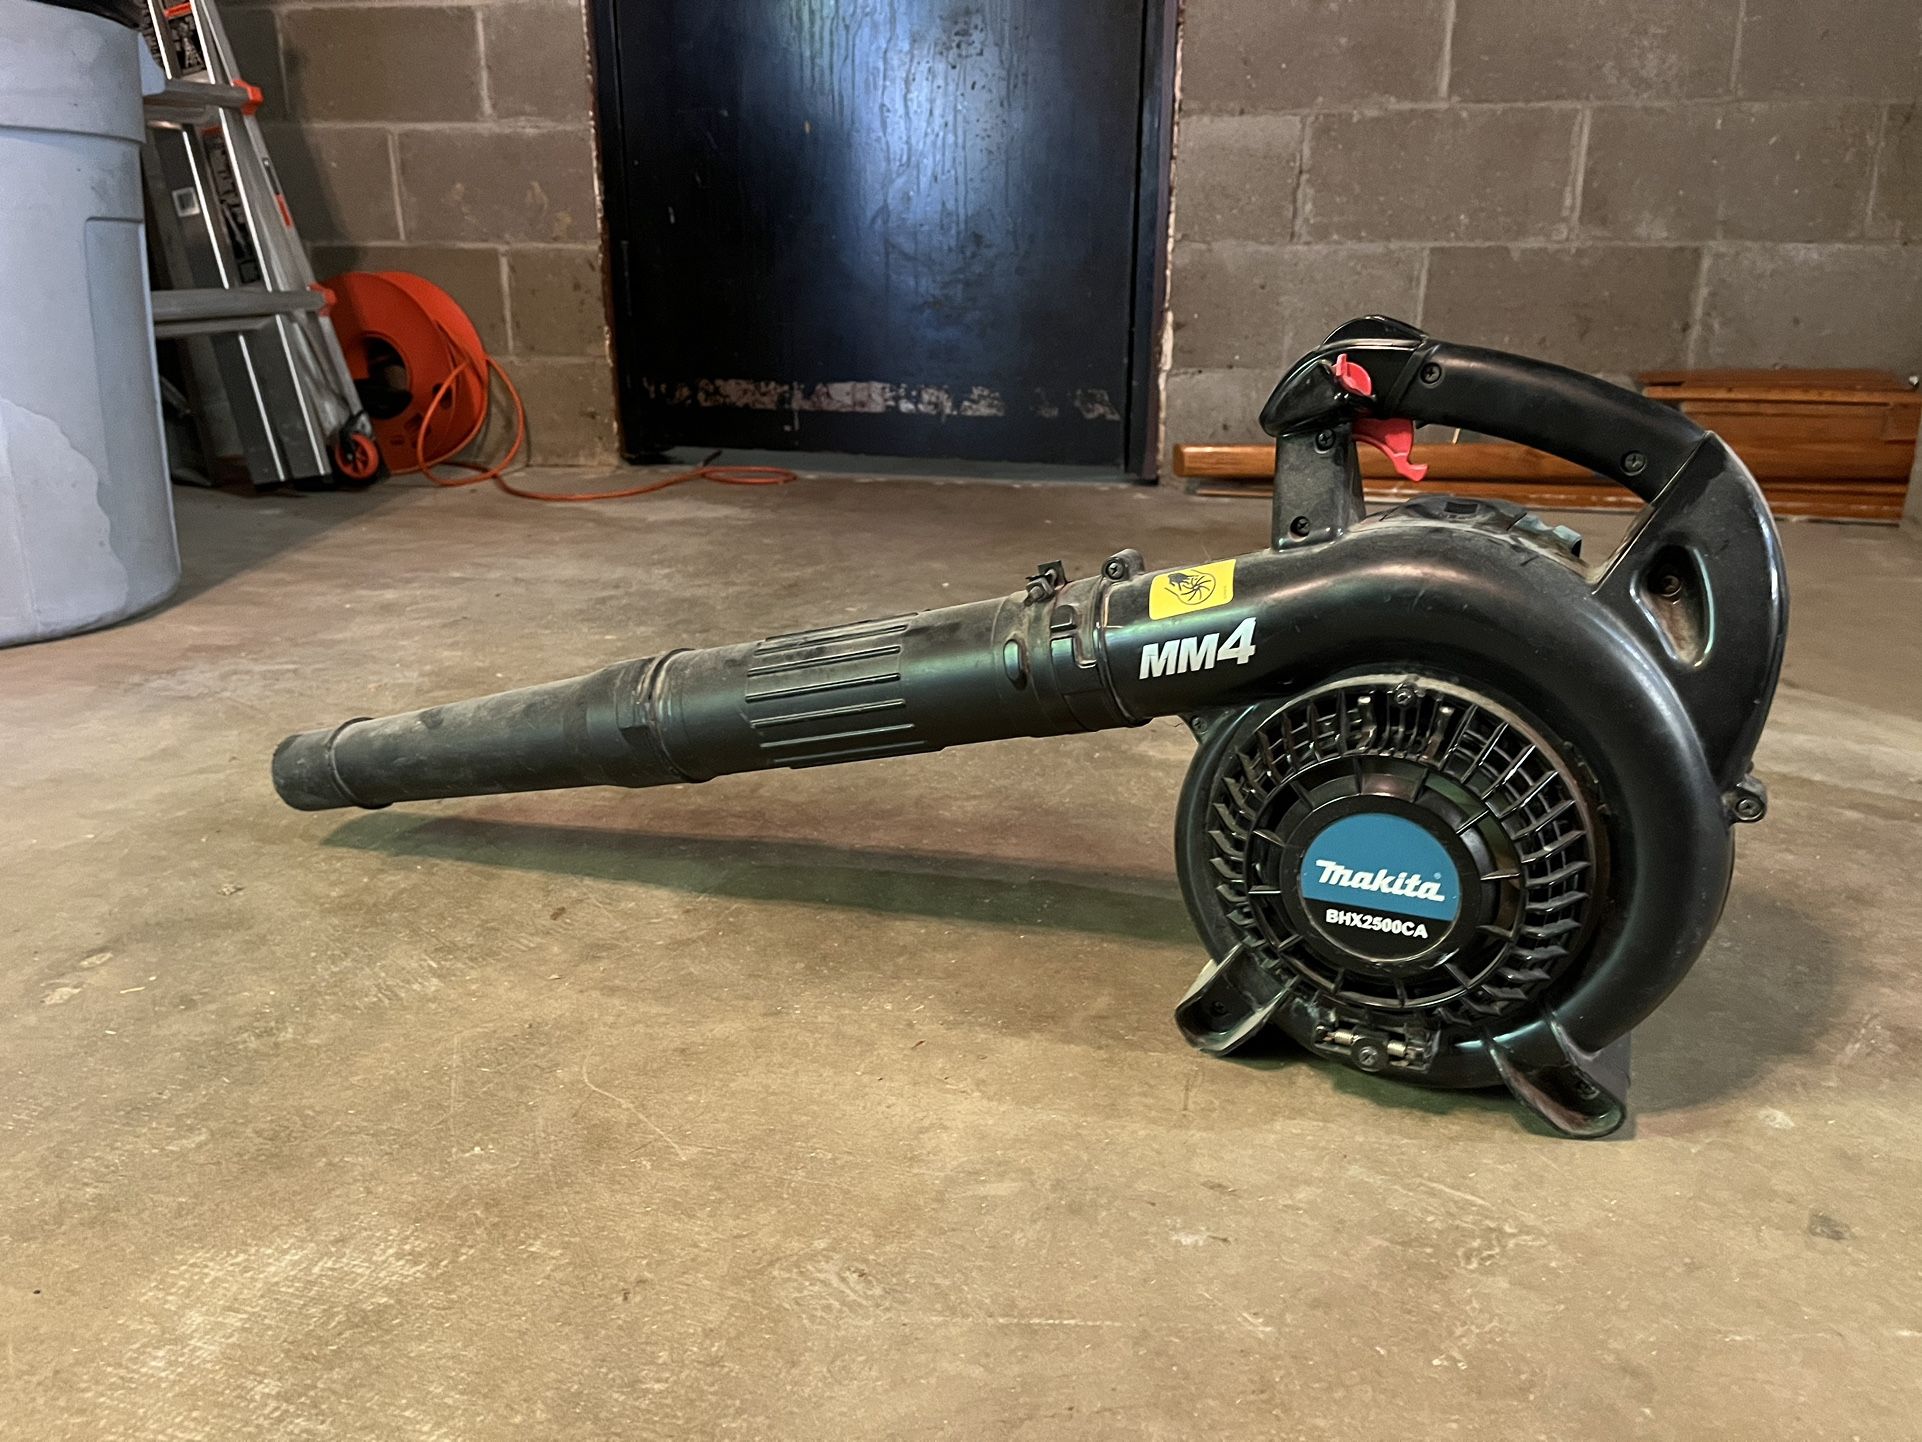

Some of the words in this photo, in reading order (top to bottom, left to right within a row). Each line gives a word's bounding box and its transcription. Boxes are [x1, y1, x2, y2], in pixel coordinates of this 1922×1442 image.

[1139, 617, 1257, 679] MM4
[1316, 859, 1445, 902] Makita
[1325, 908, 1429, 939] BHX2500CA
